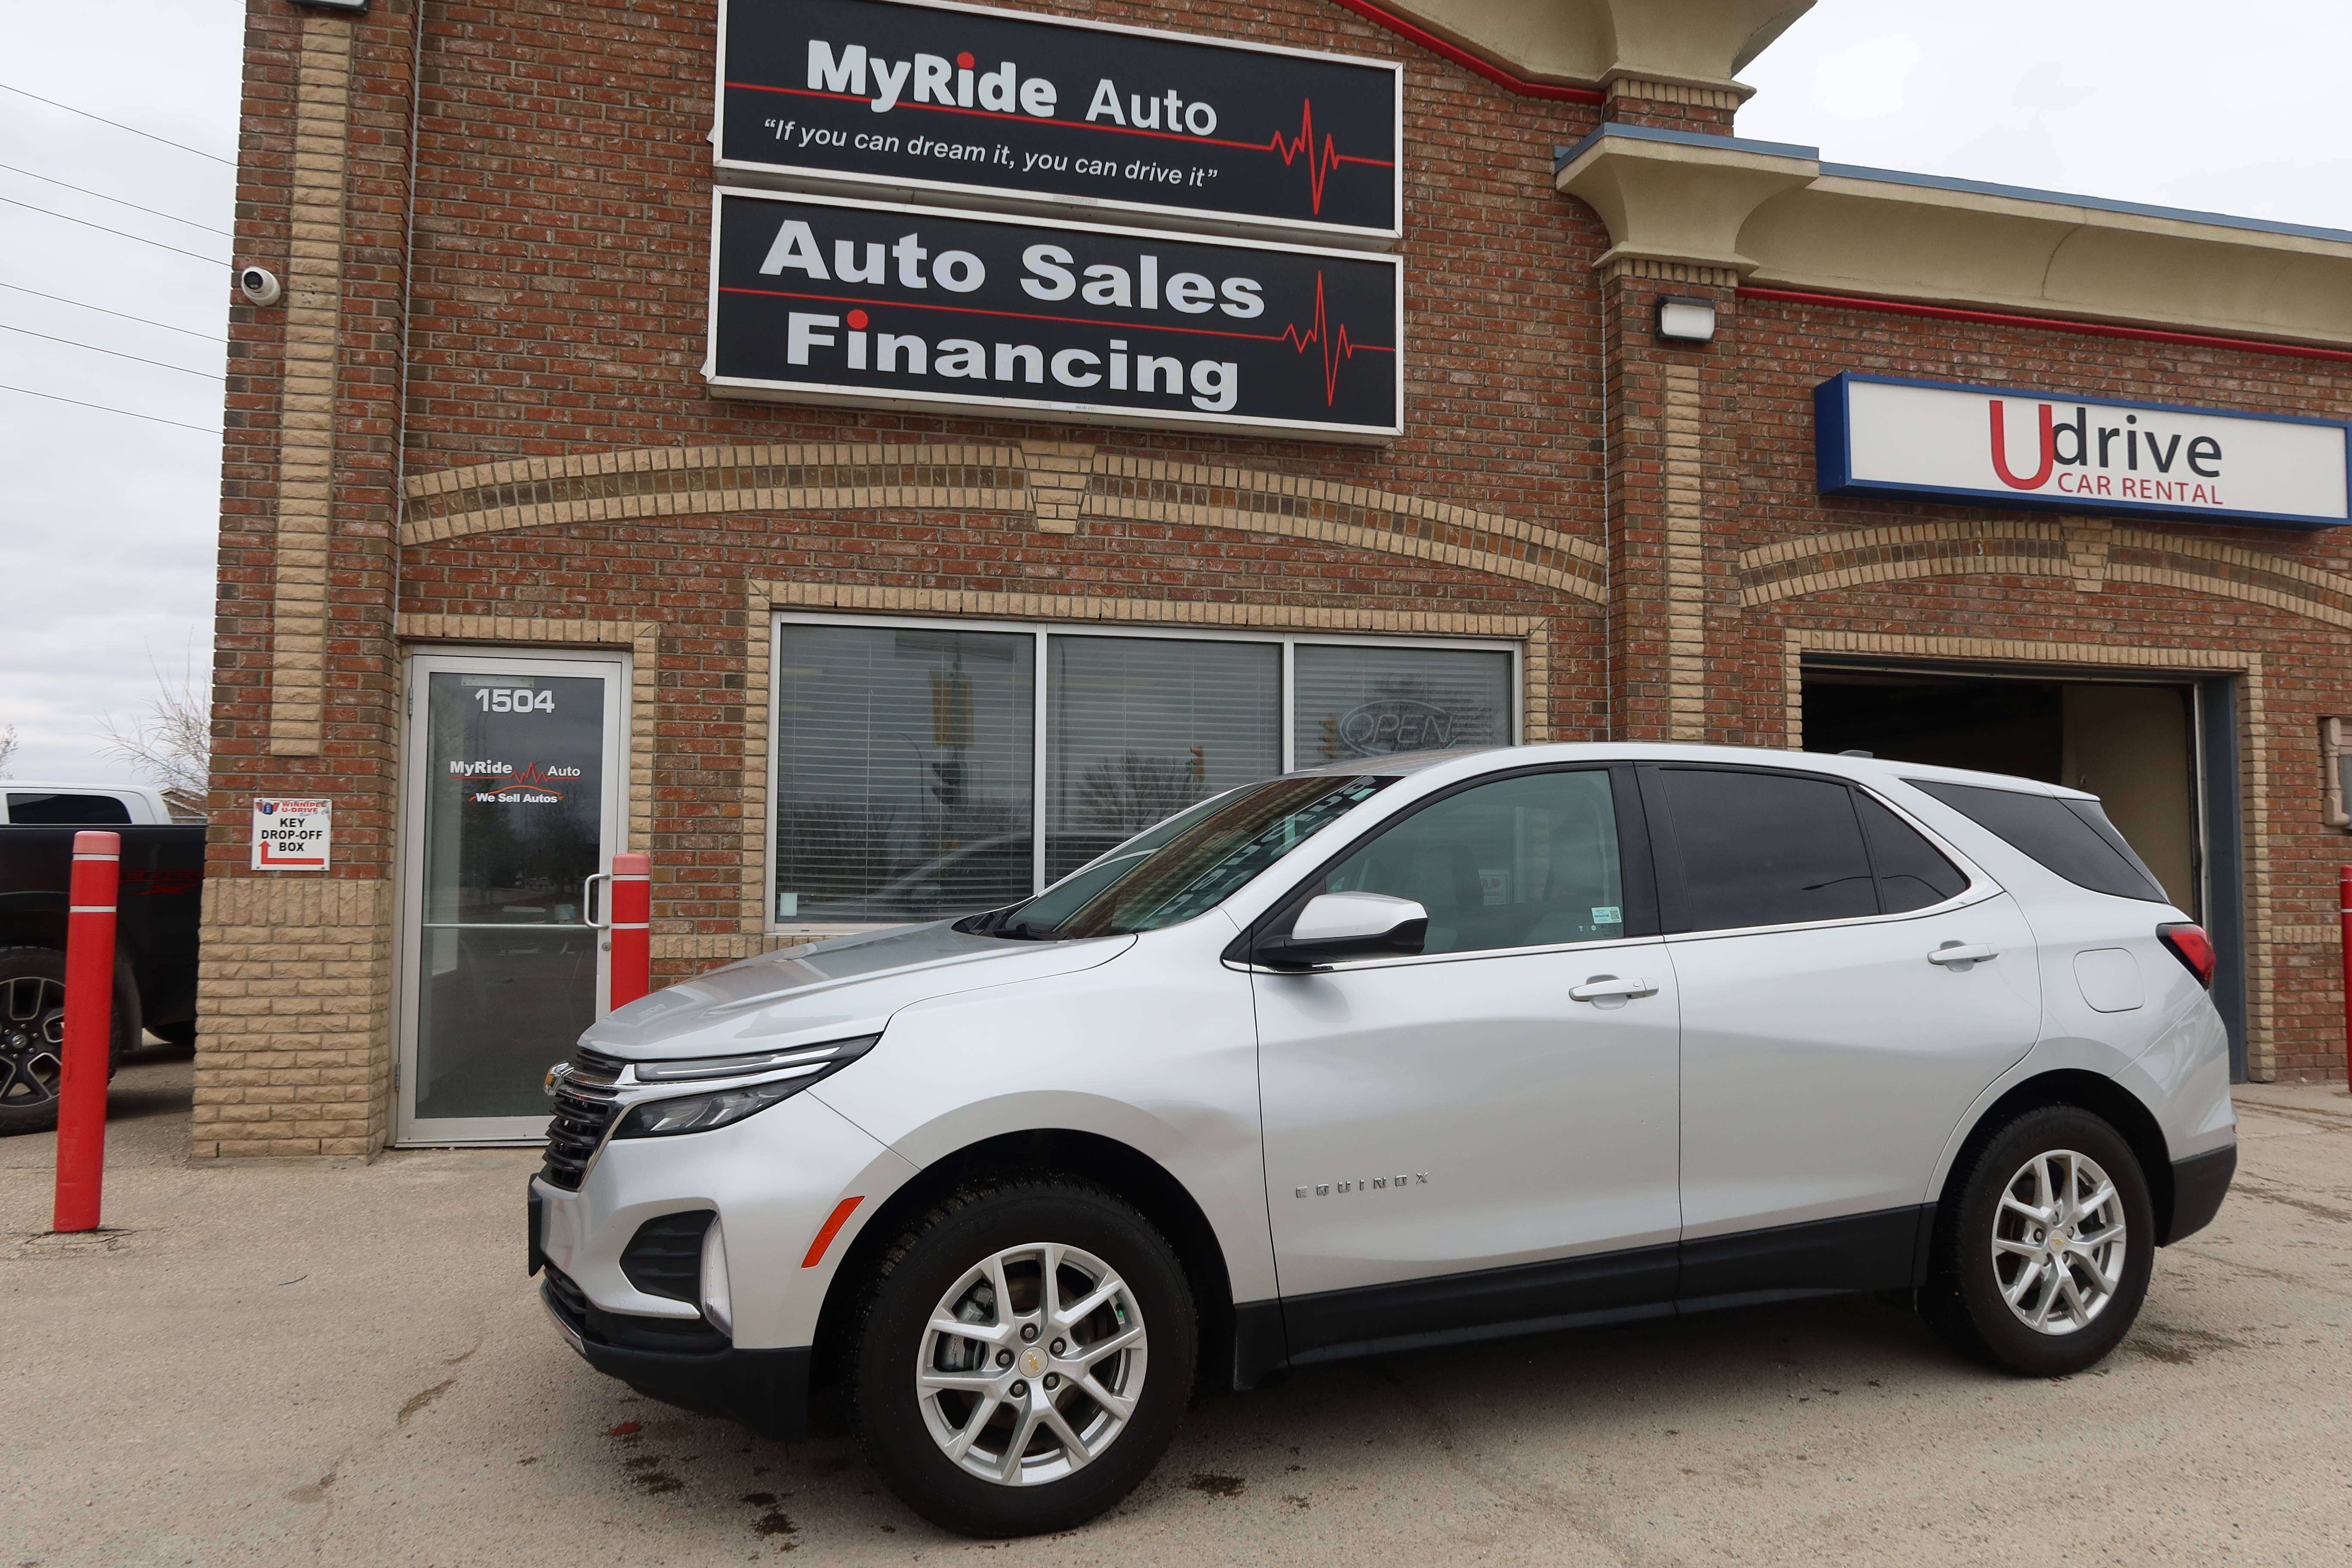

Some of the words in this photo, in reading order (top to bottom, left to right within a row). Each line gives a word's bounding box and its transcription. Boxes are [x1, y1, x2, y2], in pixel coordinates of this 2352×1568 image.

[807, 40, 1057, 117] MyRide
[1084, 78, 1217, 136] Auto
[799, 127, 847, 147] you
[854, 133, 899, 153] can
[907, 135, 986, 162] dream
[993, 145, 1015, 169] it,
[1022, 152, 1069, 172] you
[1075, 158, 1118, 177] can
[1124, 160, 1182, 184] drive
[759, 220, 986, 293] Auto
[1020, 244, 1265, 318] Sales
[787, 309, 1238, 413] Financing
[1989, 399, 2222, 490] Udrive
[2058, 472, 2112, 496] CAR
[2122, 478, 2224, 505] RENTAL
[475, 689, 555, 713] 1504
[1346, 713, 1452, 743] OPEN
[450, 759, 512, 777] MyRide
[547, 766, 581, 777] Auto
[475, 793, 495, 802] We
[498, 793, 521, 803] Sell
[522, 793, 558, 803] Autos
[261, 830, 323, 840] DROP-OFF
[280, 818, 306, 827] KEY
[279, 842, 304, 852] BOX
[1295, 1172, 1429, 1198] EQUINOX
